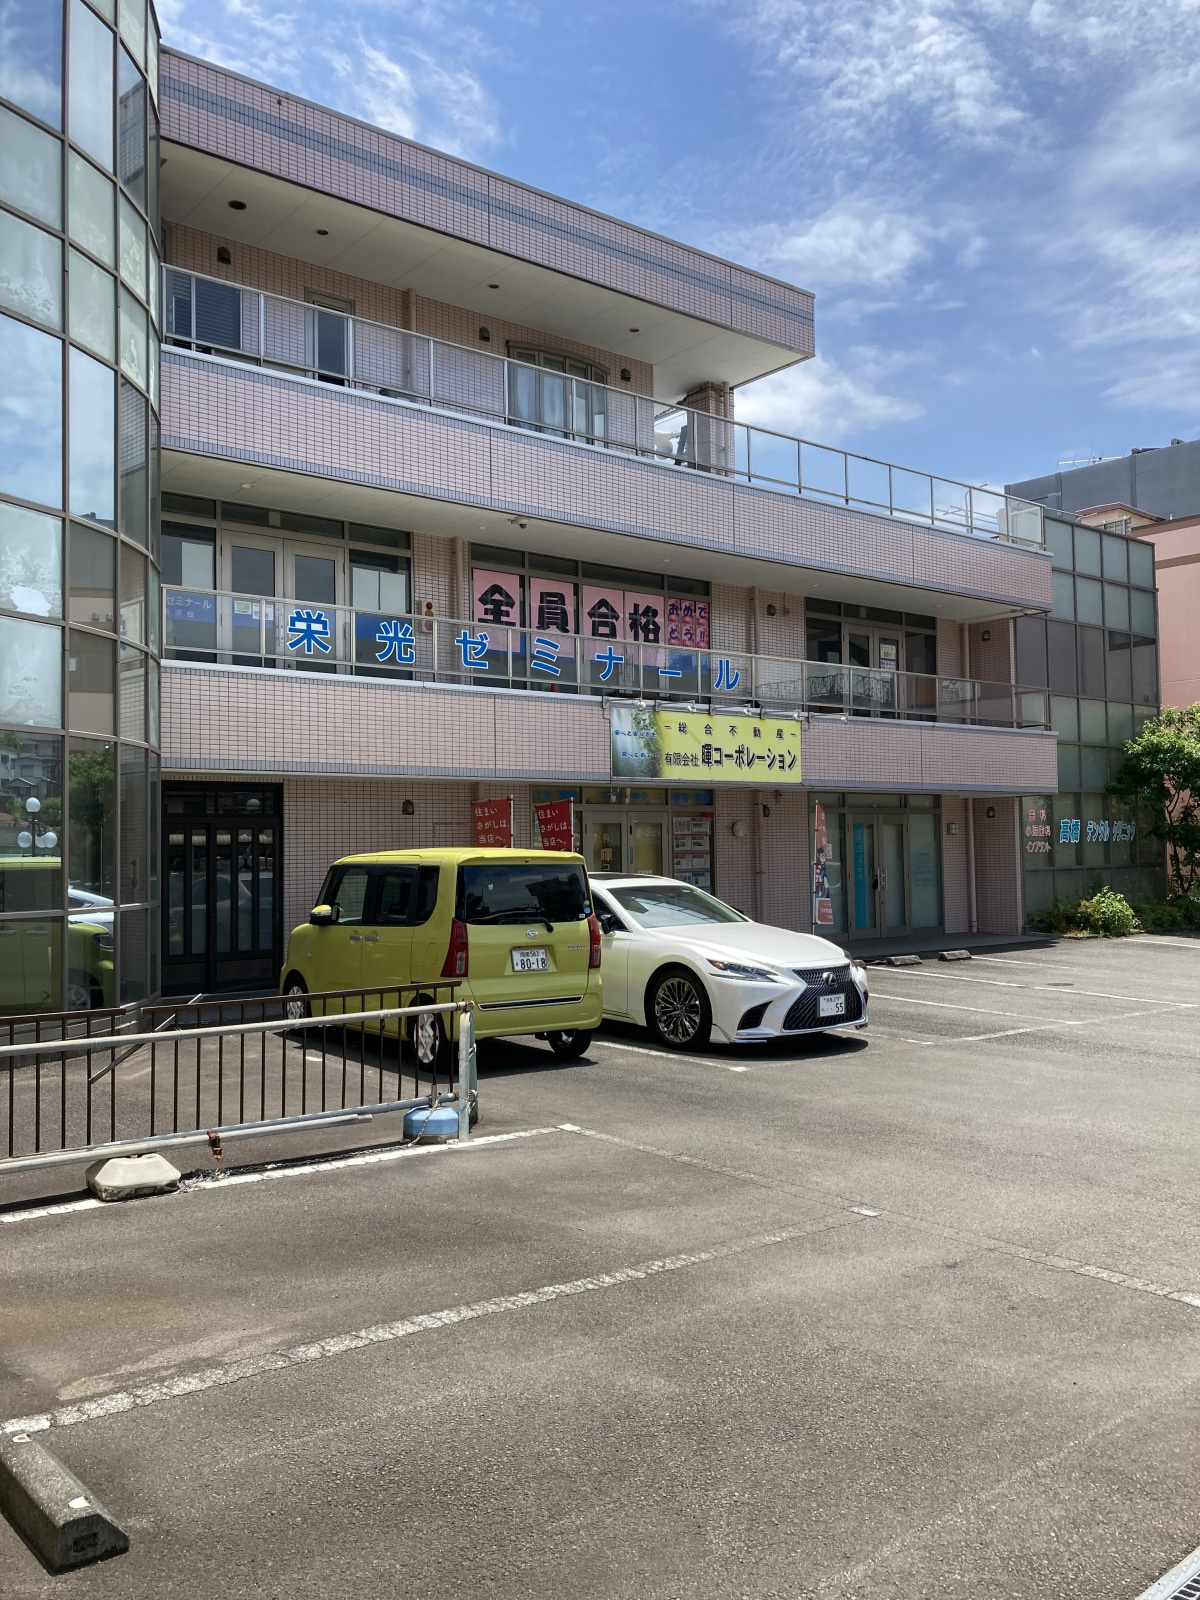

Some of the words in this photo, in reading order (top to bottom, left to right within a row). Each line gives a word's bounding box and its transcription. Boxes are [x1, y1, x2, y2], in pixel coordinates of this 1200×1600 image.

[475, 806, 498, 818] 住まい
[538, 808, 559, 819] 住まい
[520, 957, 547, 970] 80-18
